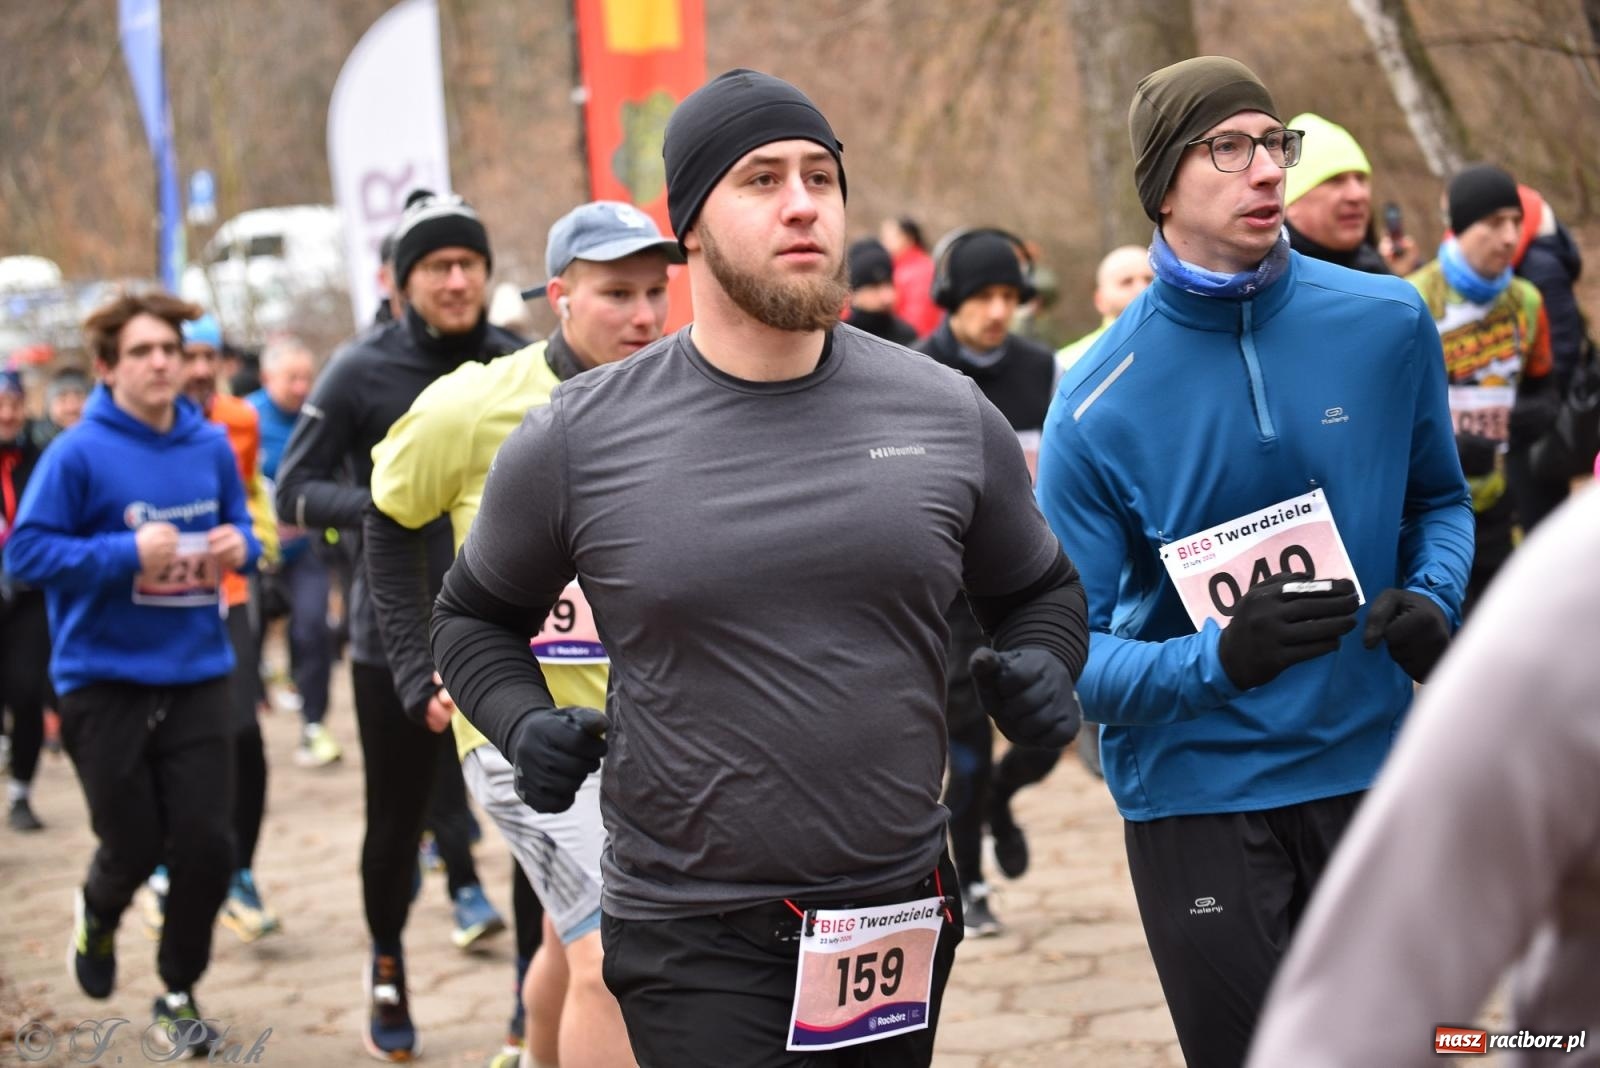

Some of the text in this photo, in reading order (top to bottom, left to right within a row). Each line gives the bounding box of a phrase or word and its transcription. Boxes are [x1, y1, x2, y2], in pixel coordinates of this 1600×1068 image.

[1177, 501, 1312, 560] BIEG Twardziela
[544, 599, 576, 634] 9
[820, 906, 935, 934] BIEG Twardziela
[837, 947, 905, 1007] 159
